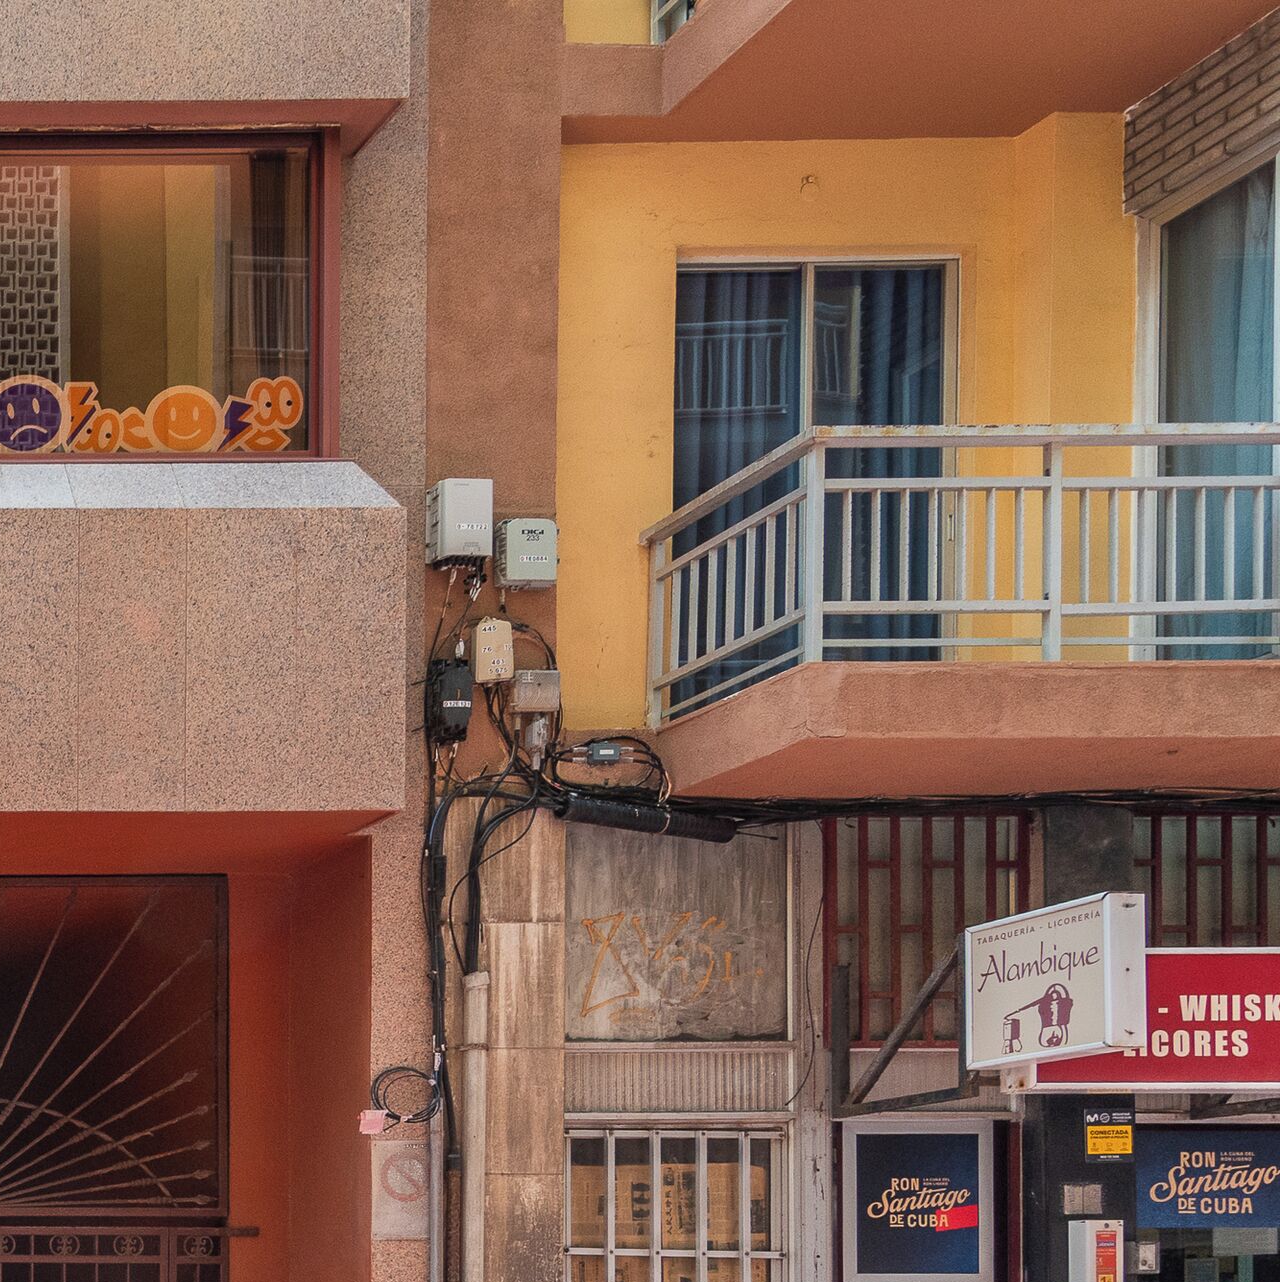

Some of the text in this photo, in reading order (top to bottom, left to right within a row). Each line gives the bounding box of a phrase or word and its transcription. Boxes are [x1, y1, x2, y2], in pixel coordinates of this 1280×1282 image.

[977, 925, 1036, 945] TABAQUERÍA
[1047, 911, 1101, 929] LICORERÍA
[977, 941, 1101, 992] Alambique
[1123, 1029, 1249, 1057] CORES
[1180, 1151, 1216, 1168] RON
[891, 1178, 920, 1191] RON
[1149, 1164, 1280, 1203] Santiago
[866, 1187, 971, 1219] Santiago
[1178, 1198, 1253, 1214] DE CUBA
[890, 1214, 949, 1228] DE CUBA
